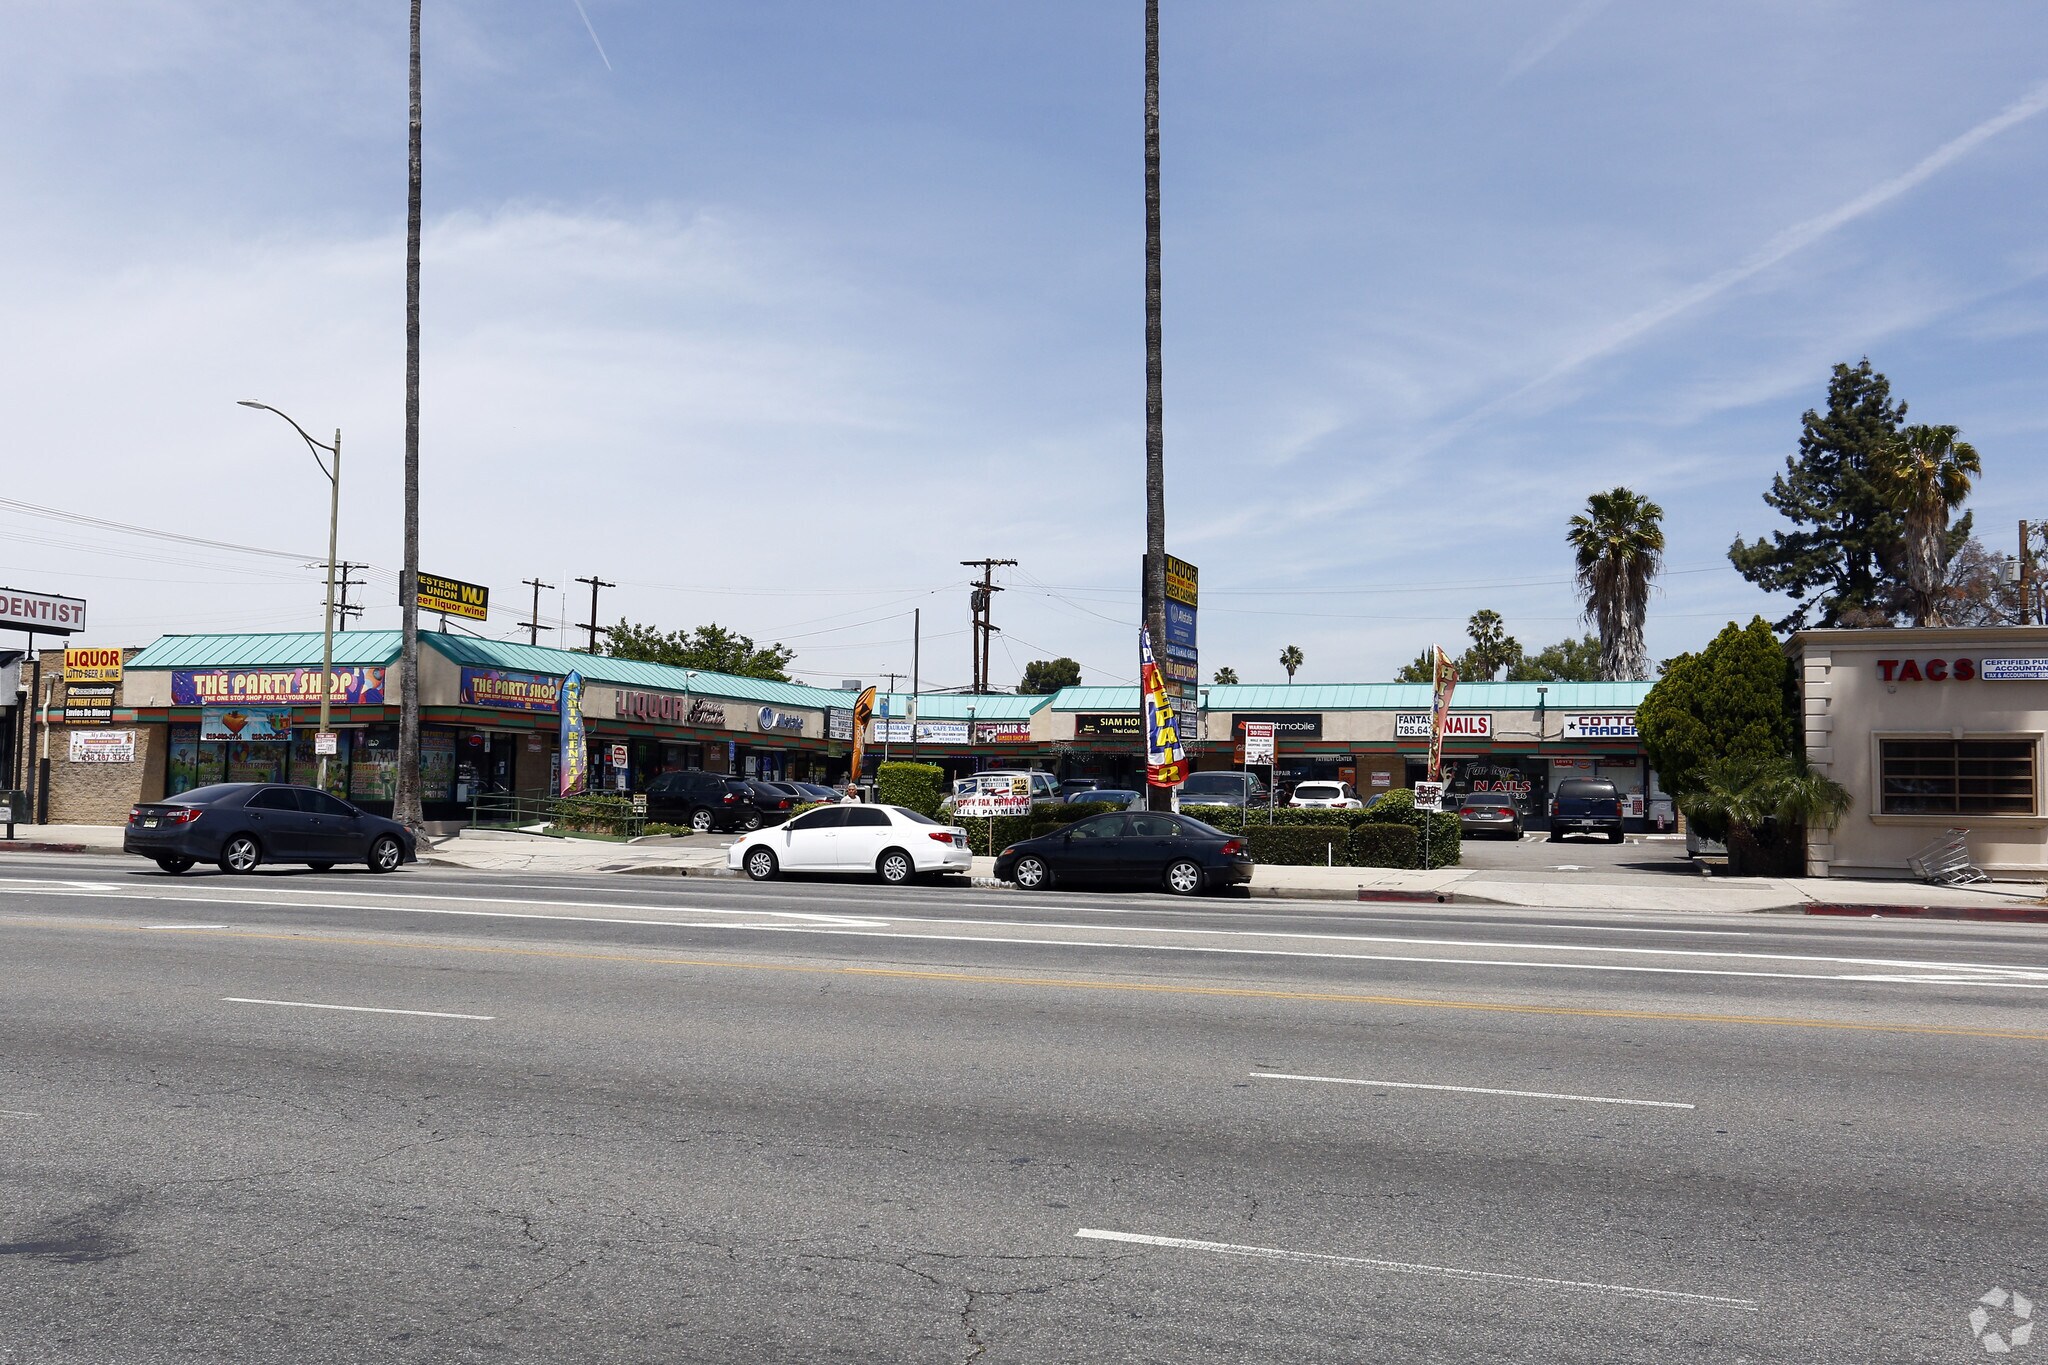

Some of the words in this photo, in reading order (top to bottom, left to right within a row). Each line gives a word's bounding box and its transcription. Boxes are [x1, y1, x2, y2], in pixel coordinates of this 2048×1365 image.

[1167, 557, 1197, 583] LIQUOR
[417, 575, 458, 591] ESTERN
[461, 585, 484, 605] WU
[426, 586, 458, 600] UNION
[0, 596, 83, 624] DENTIST
[417, 596, 432, 605] eer
[435, 597, 462, 611] liquor
[464, 605, 485, 617] wine
[66, 650, 120, 668] LIQUOR
[65, 669, 83, 679] LOTTO
[84, 669, 99, 678] BEER
[105, 669, 119, 678] WINE
[1877, 658, 1976, 682] TACS
[193, 674, 228, 695] THE
[233, 673, 295, 694] PARTY
[472, 678, 492, 693] THE
[495, 680, 527, 697] PARTY
[530, 683, 556, 699] SHOP
[66, 698, 91, 706] PAYMENT
[91, 698, 112, 706] CENTER
[567, 682, 579, 726] PARTY
[617, 690, 685, 721] LIQUOR
[996, 724, 1018, 733] HAIR
[1100, 718, 1122, 726] SIAM
[1124, 718, 1140, 726] HO
[1151, 668, 1181, 783] REPAIR
[1274, 722, 1315, 731] stmobile
[1444, 717, 1487, 734] NAILS
[1579, 716, 1635, 726] COTTO
[1474, 780, 1531, 792] NAILS
[993, 797, 1030, 807] PRINTING
[982, 808, 1029, 816] PAYMENT
